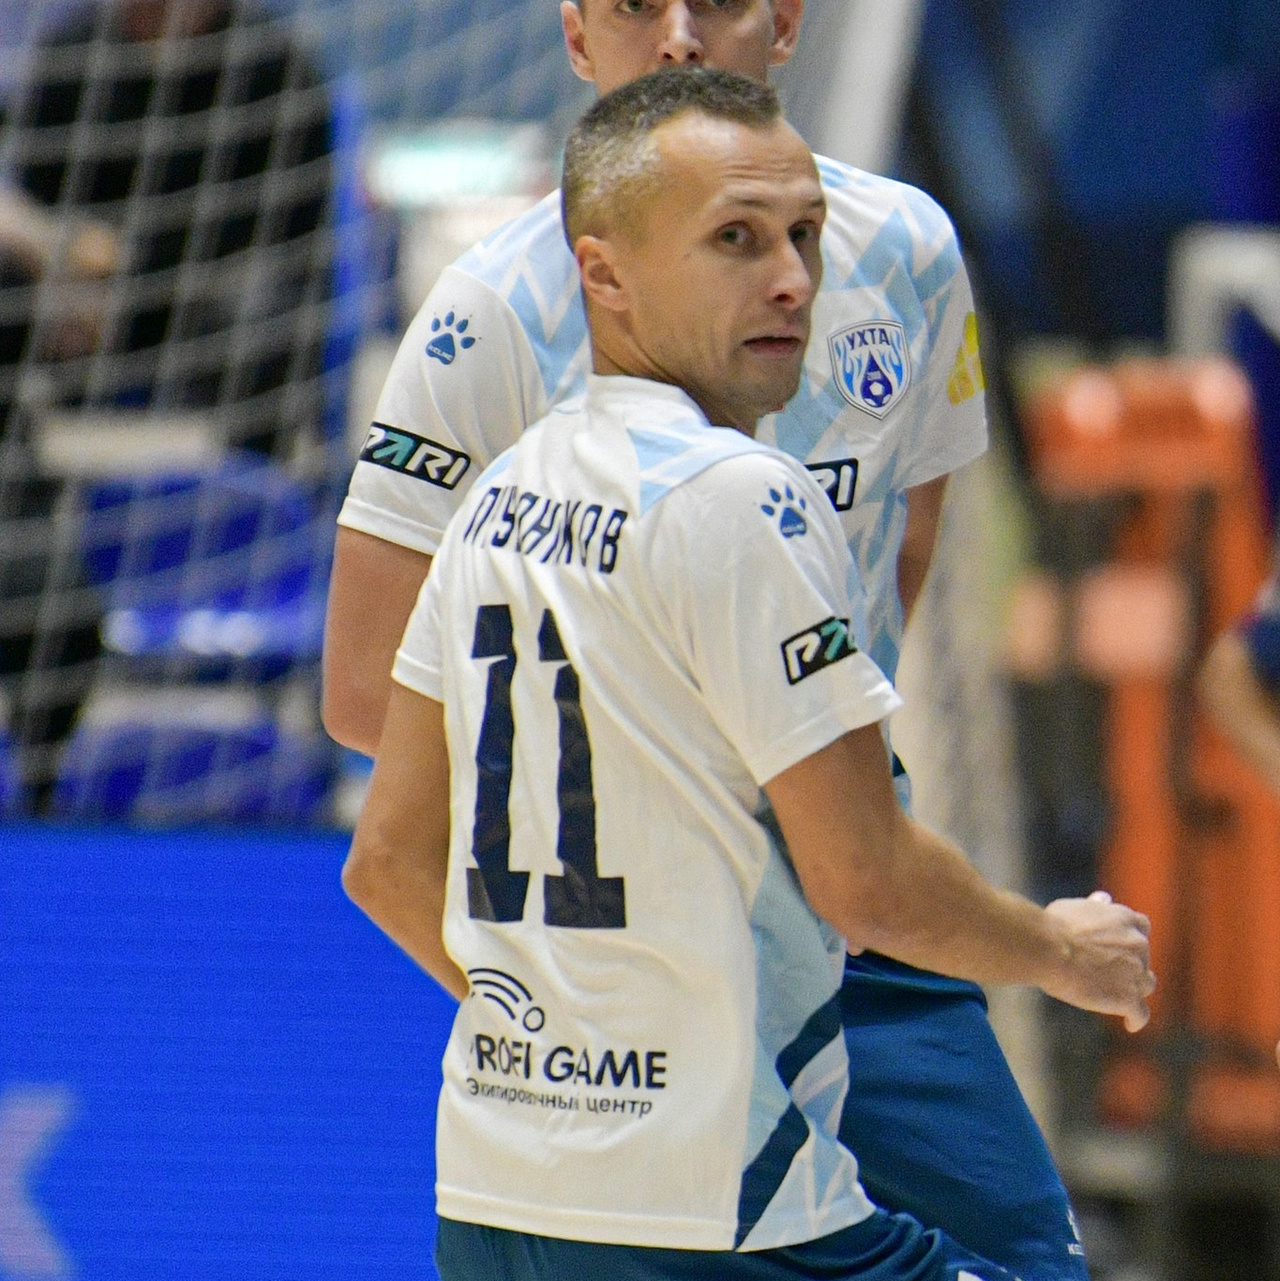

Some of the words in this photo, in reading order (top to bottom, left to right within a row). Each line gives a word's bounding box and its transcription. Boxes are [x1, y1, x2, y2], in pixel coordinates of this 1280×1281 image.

[846, 328, 891, 351] УХТА
[466, 604, 627, 929] 11
[468, 1033, 532, 1080] ROFI
[543, 1045, 668, 1090] GAME
[586, 1097, 653, 1118] центр
